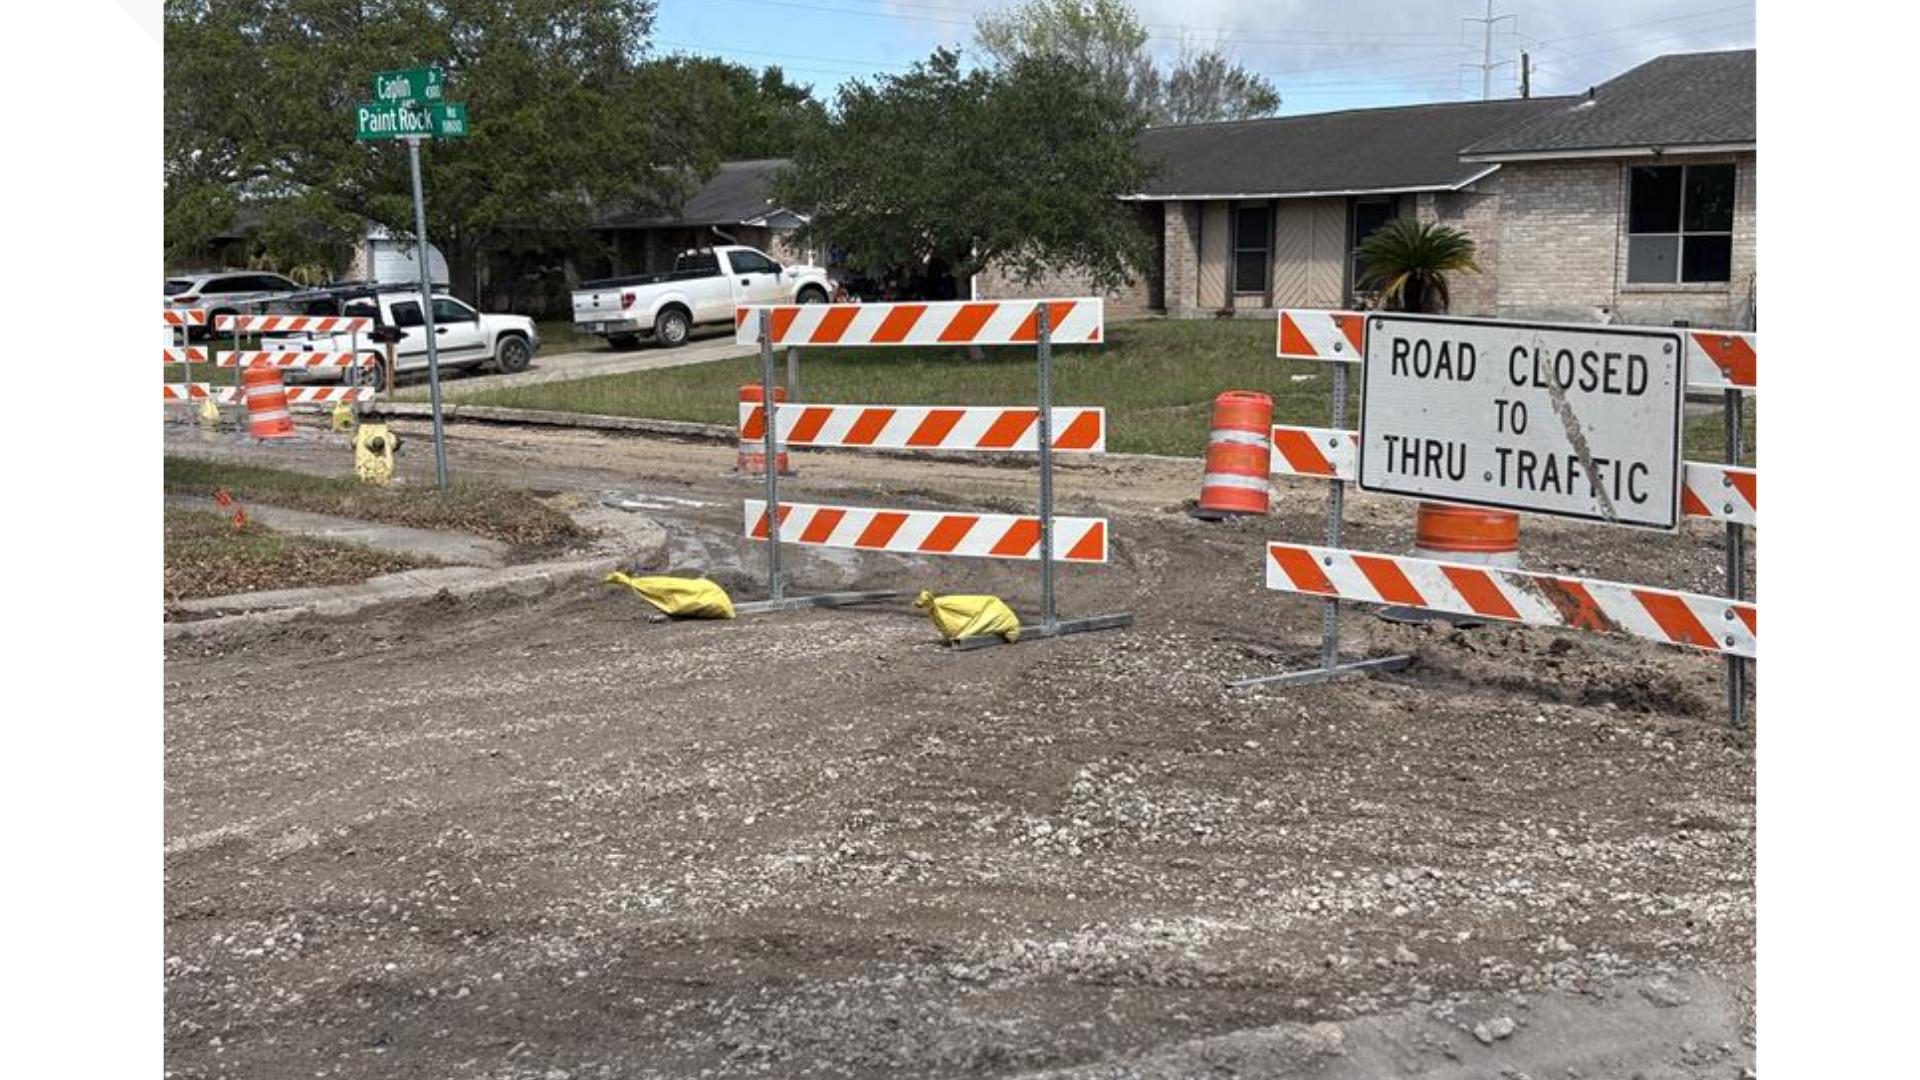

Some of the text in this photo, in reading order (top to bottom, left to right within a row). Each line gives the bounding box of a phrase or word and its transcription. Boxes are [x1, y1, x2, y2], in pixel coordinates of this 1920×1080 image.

[378, 75, 411, 103] Caplin
[359, 108, 397, 132] Paint
[398, 107, 433, 130] Rock
[1391, 337, 1648, 395] ROAD CLOSED
[1494, 399, 1527, 435] TO
[1384, 436, 1648, 504] THRU TRAFFIC
